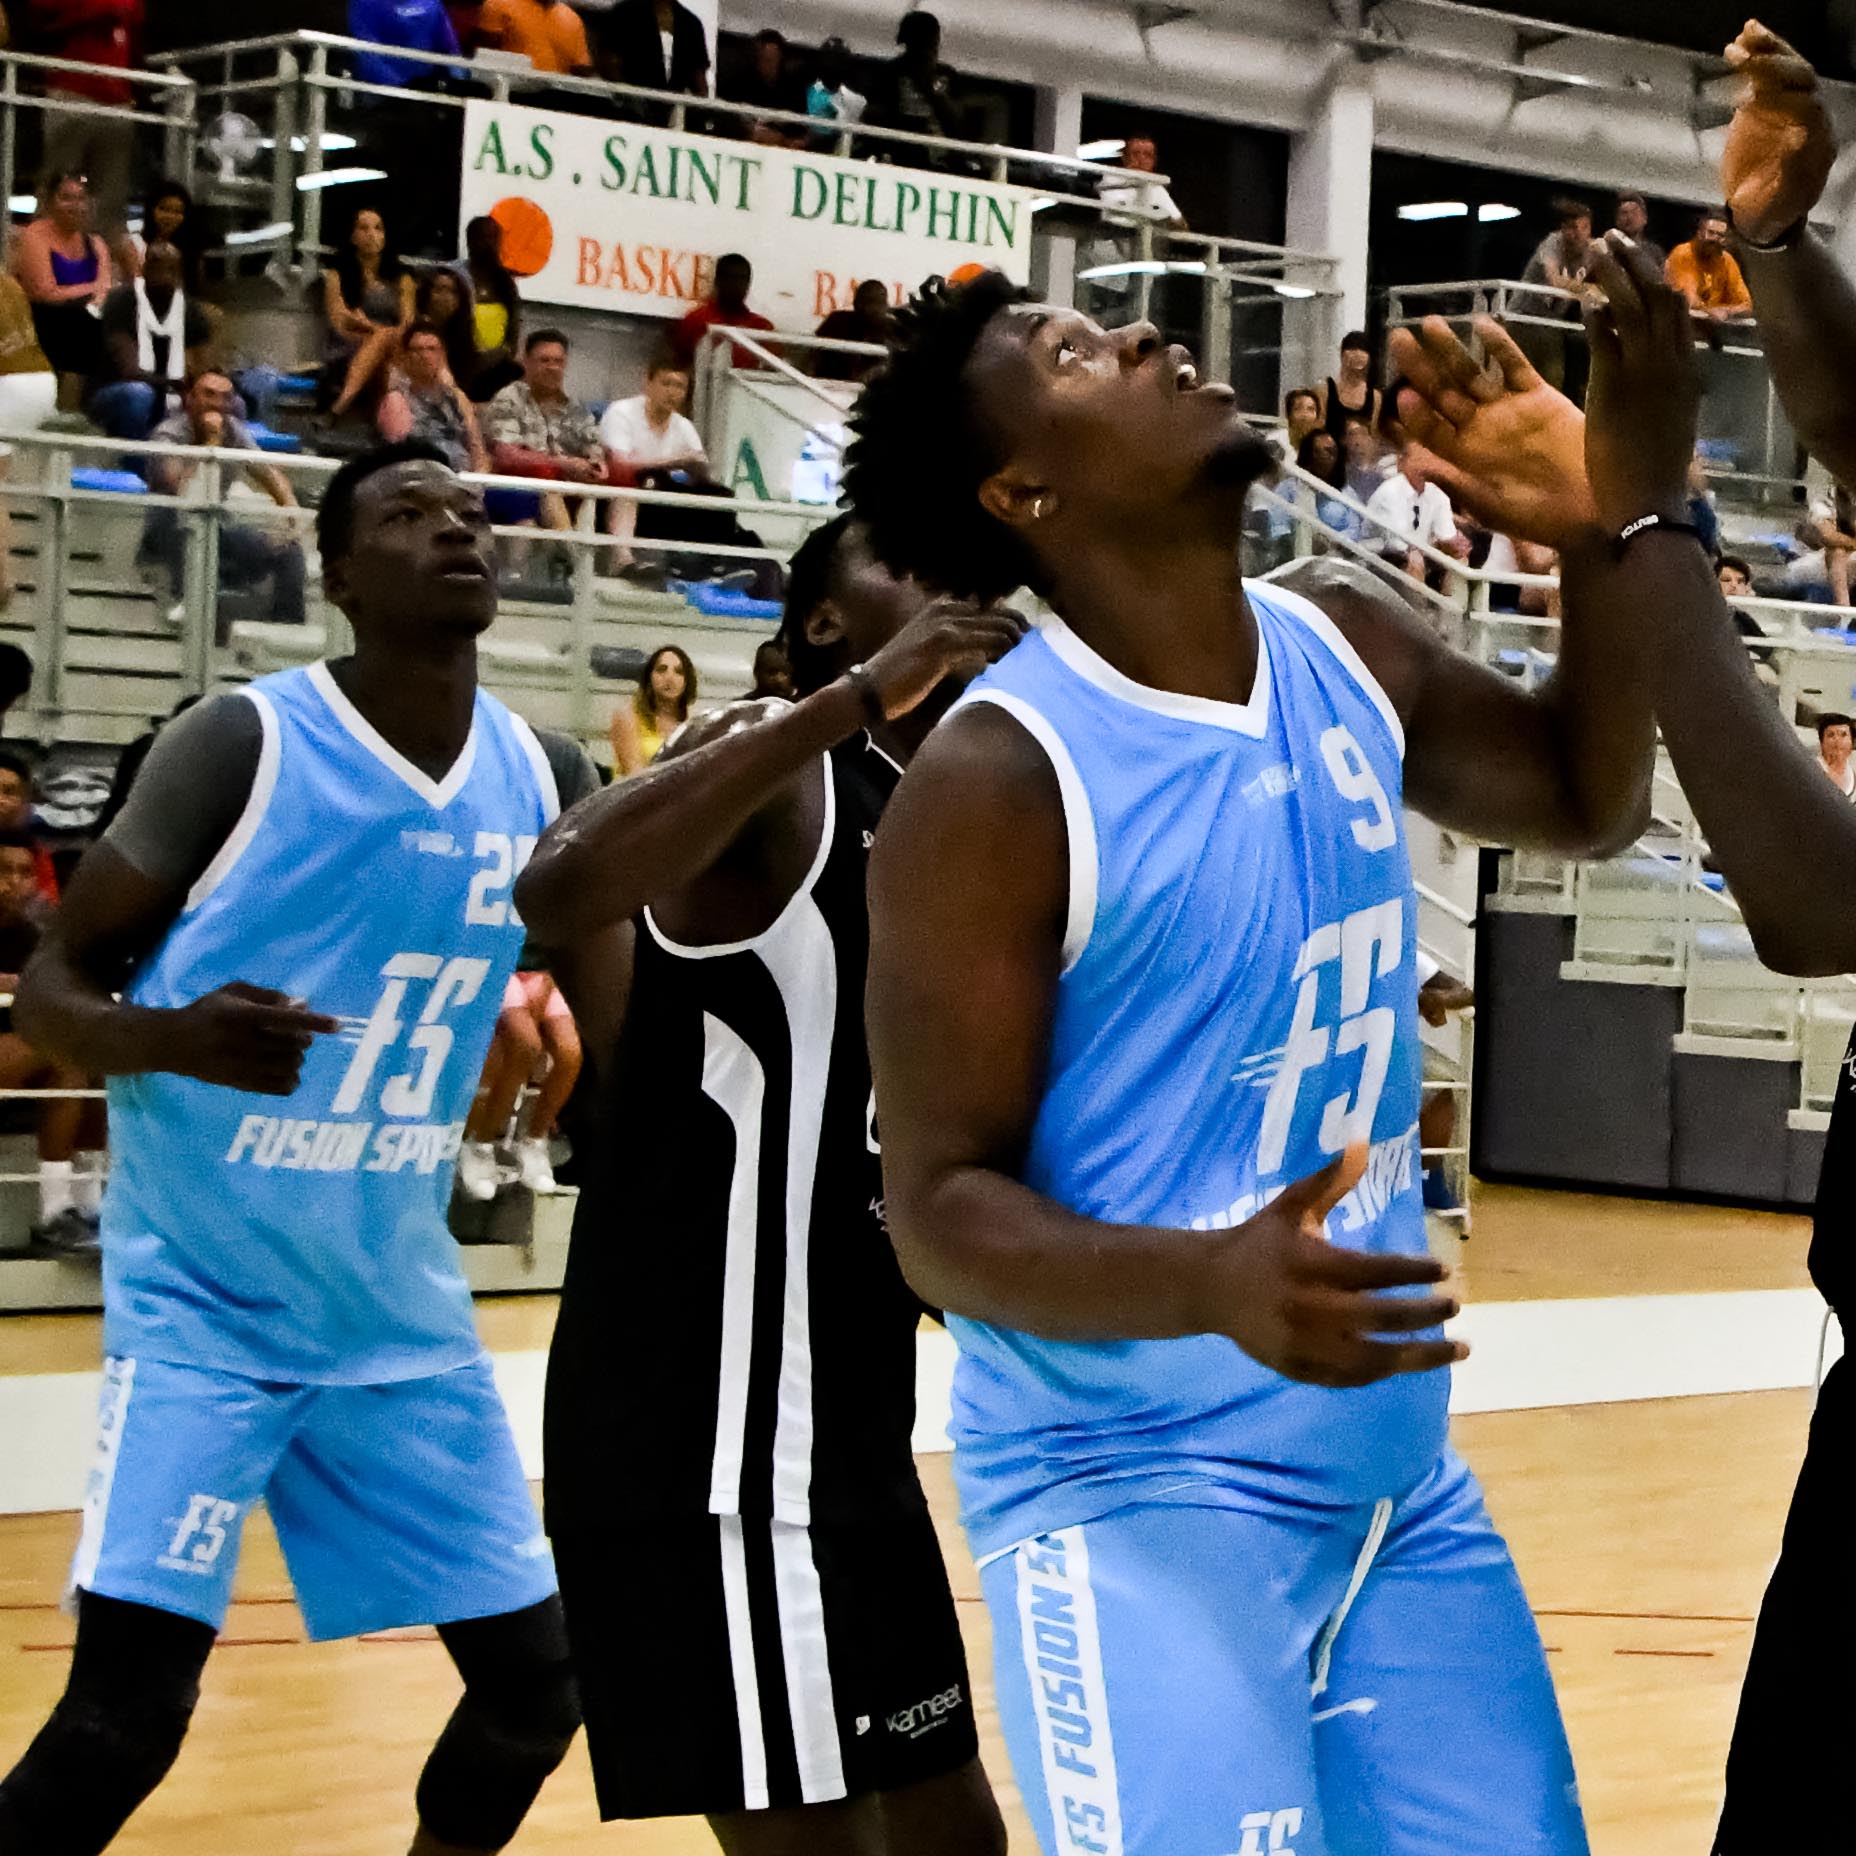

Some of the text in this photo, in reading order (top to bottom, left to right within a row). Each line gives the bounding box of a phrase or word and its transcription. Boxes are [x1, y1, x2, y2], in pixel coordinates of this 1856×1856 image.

[600, 135, 762, 211] SAINT
[791, 163, 1020, 249] DELPHIN
[575, 235, 714, 301] BASKE
[1319, 723, 1398, 853] 9
[225, 1114, 374, 1172] FUSION
[1030, 1582, 1098, 1779] FUSION
